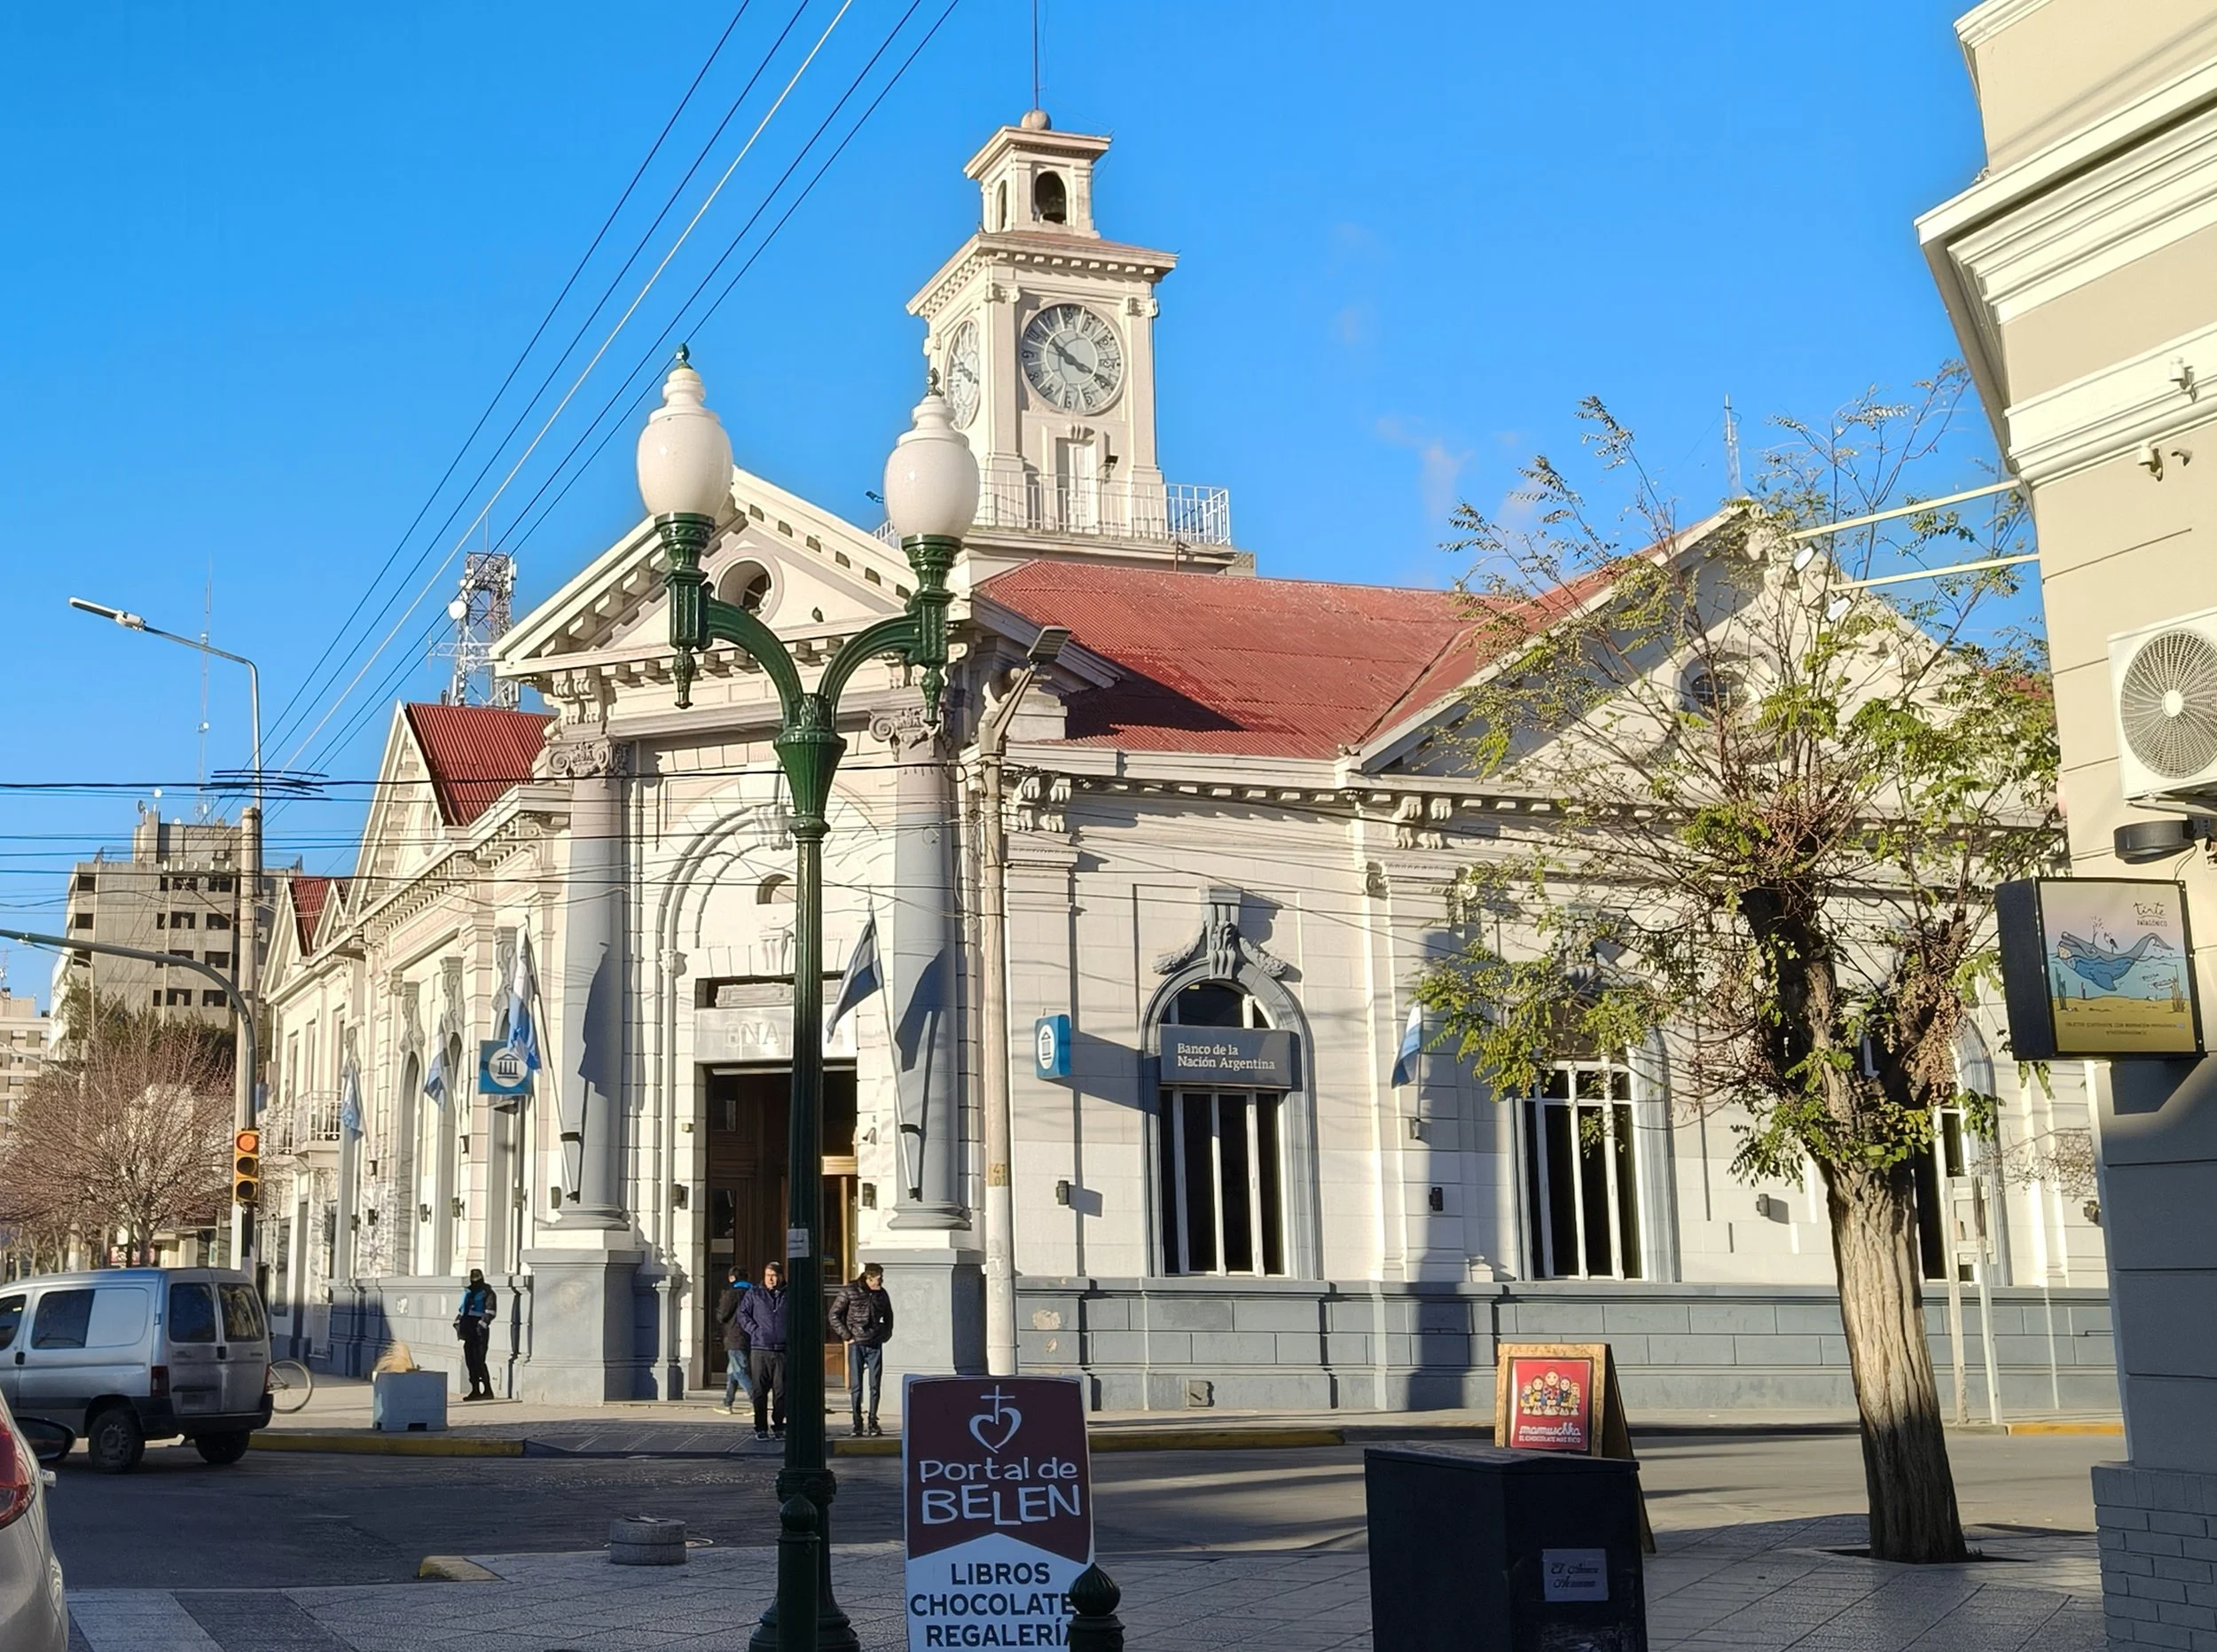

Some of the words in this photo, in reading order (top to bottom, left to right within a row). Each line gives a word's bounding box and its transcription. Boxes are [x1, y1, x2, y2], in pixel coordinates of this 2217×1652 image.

[1178, 1043, 1210, 1055] Banco
[1212, 1044, 1226, 1055] de
[1228, 1044, 1239, 1056] la
[1177, 1055, 1216, 1068] Nación
[1219, 1058, 1275, 1071] Argentina
[920, 1457, 1029, 1483] Portal
[1038, 1457, 1078, 1479] de
[922, 1484, 1081, 1525] BELEN
[952, 1562, 1050, 1585] LIBROS
[910, 1593, 1077, 1617] CHOCOLATE
